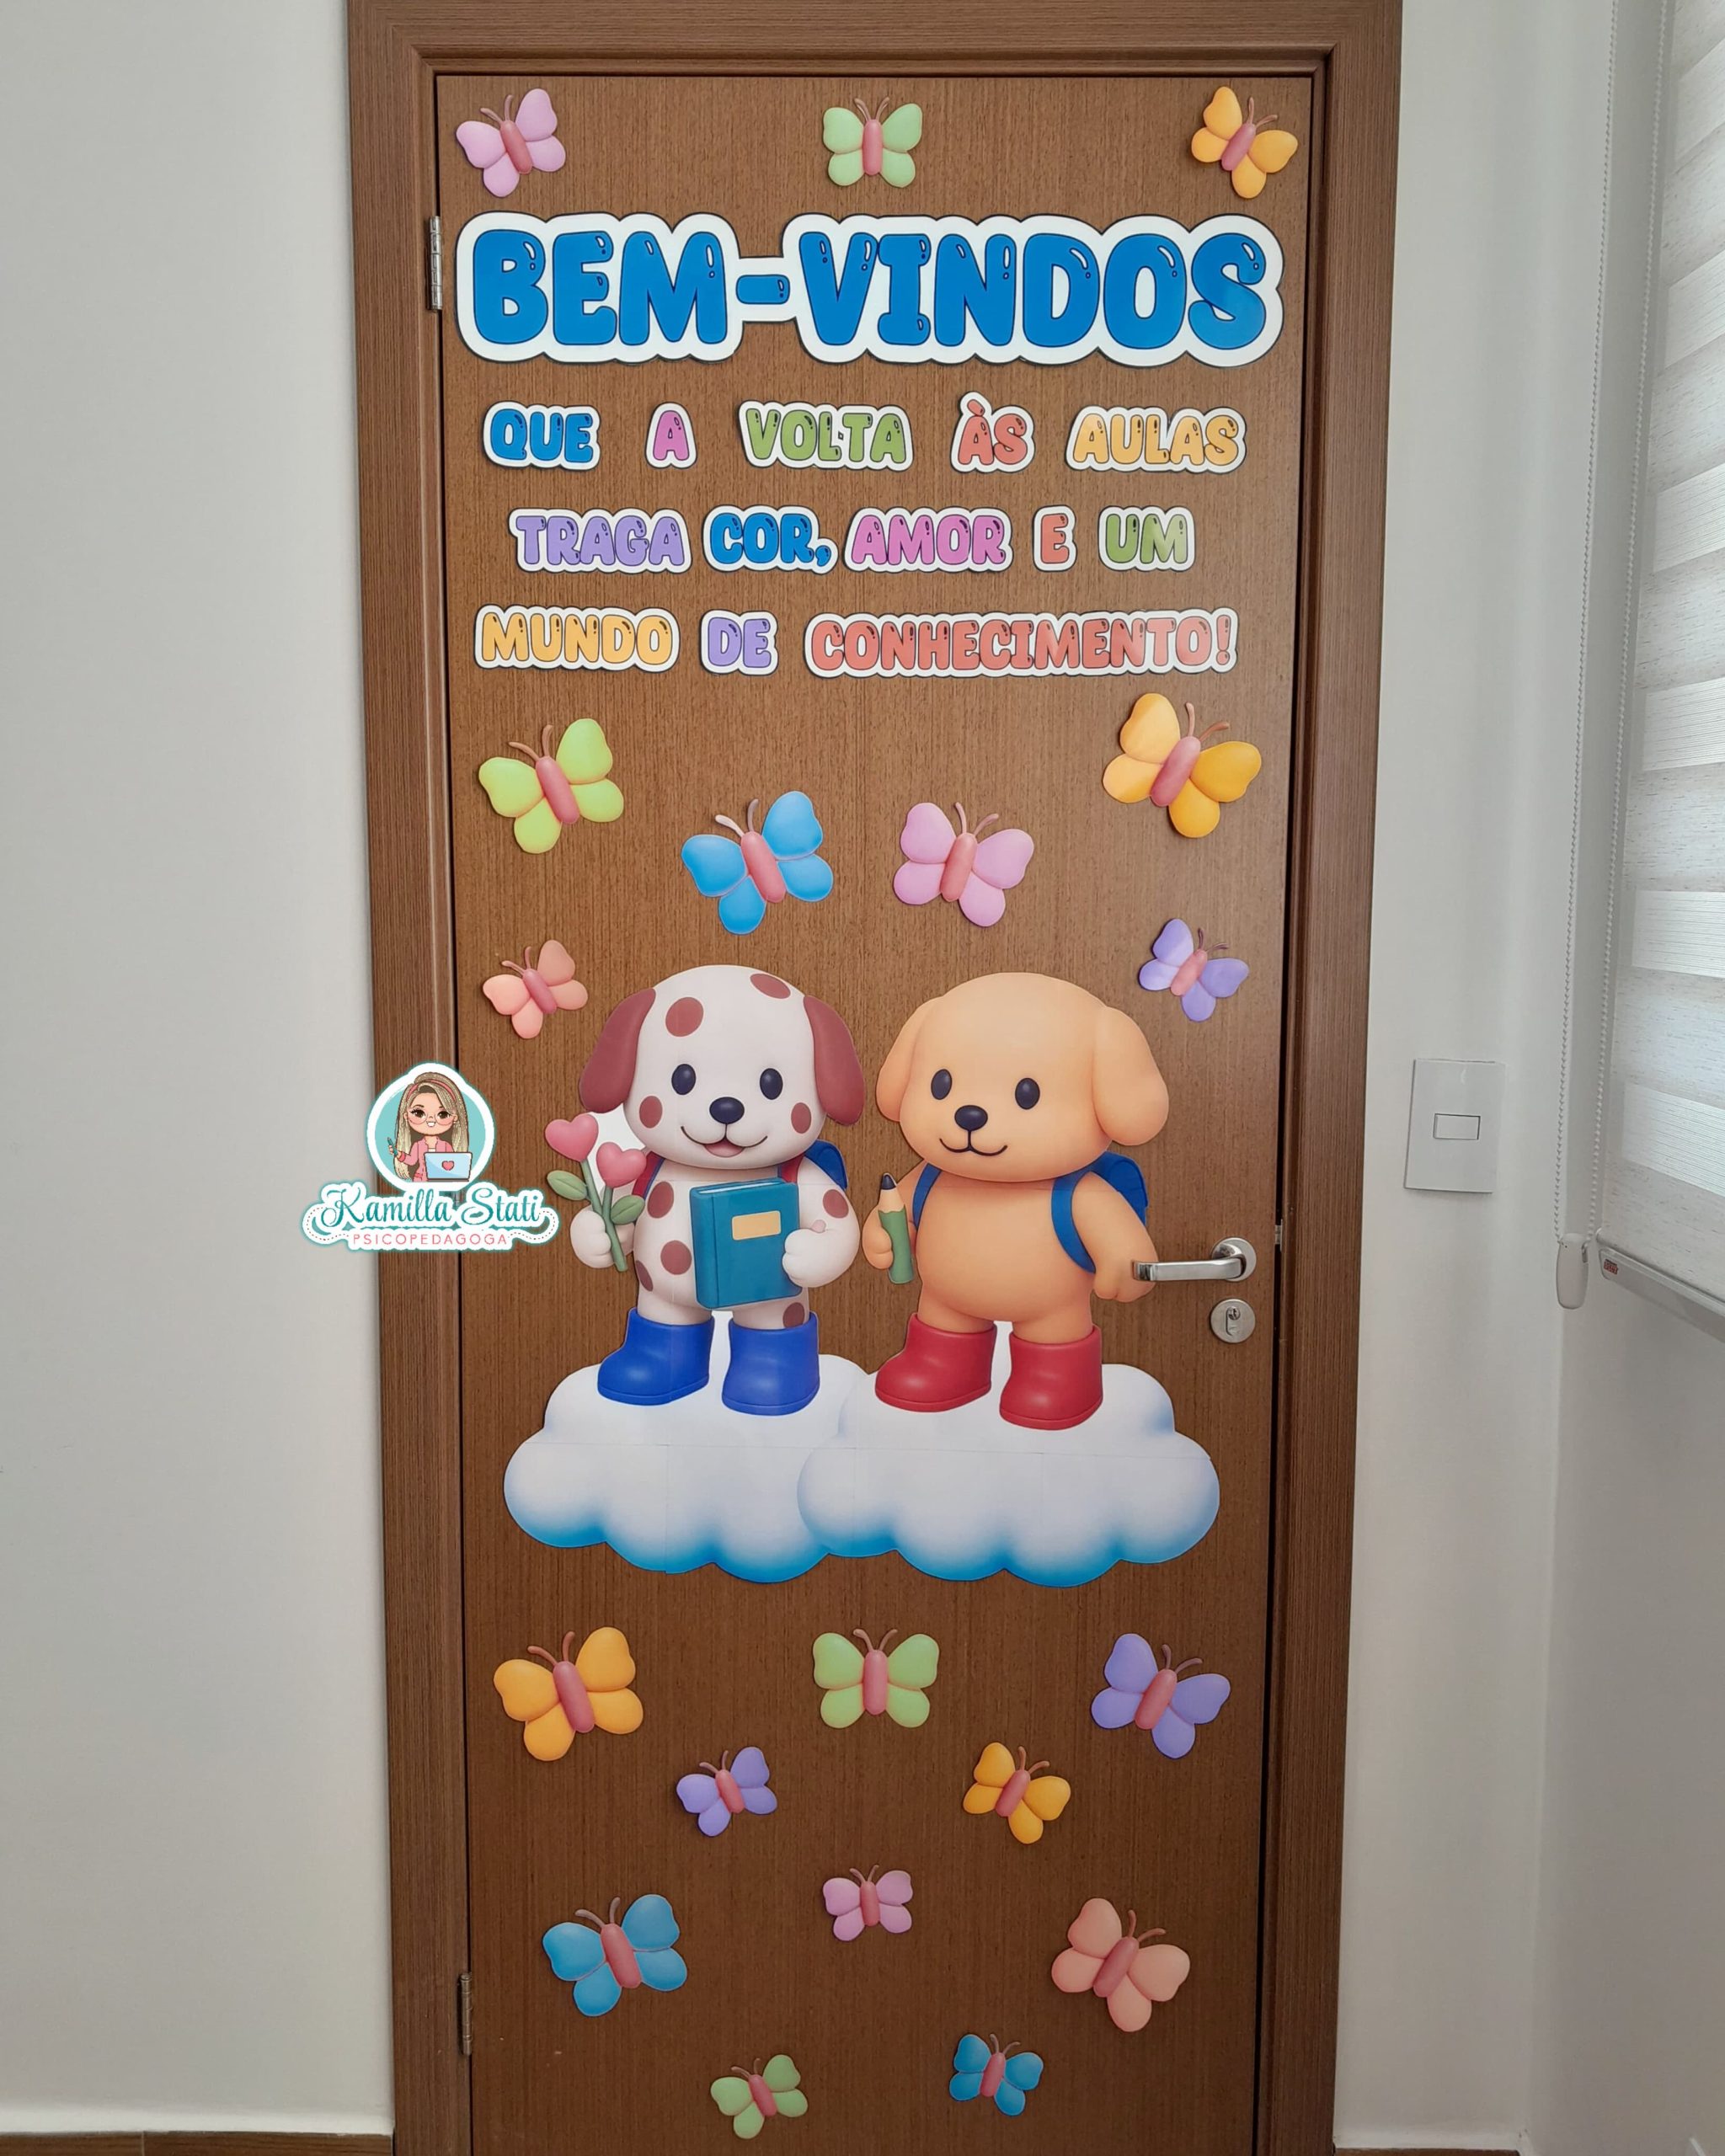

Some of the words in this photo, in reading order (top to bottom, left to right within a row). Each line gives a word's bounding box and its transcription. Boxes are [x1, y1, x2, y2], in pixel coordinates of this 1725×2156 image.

[472, 229, 1266, 350] BEM-VINDOS
[489, 408, 595, 463] QUE
[654, 409, 691, 462] A
[745, 408, 906, 462] VOLTA
[958, 399, 1029, 464] ÀS
[1072, 414, 1239, 465] AULAS
[515, 515, 685, 566] TRAGA
[710, 513, 833, 568] COR,
[852, 515, 1007, 565] AMOR
[1040, 514, 1070, 563] E
[1107, 514, 1188, 564] UM
[482, 612, 674, 664] MUNDO
[708, 618, 772, 667] DE
[810, 616, 1232, 670] CONHECIMENTO!
